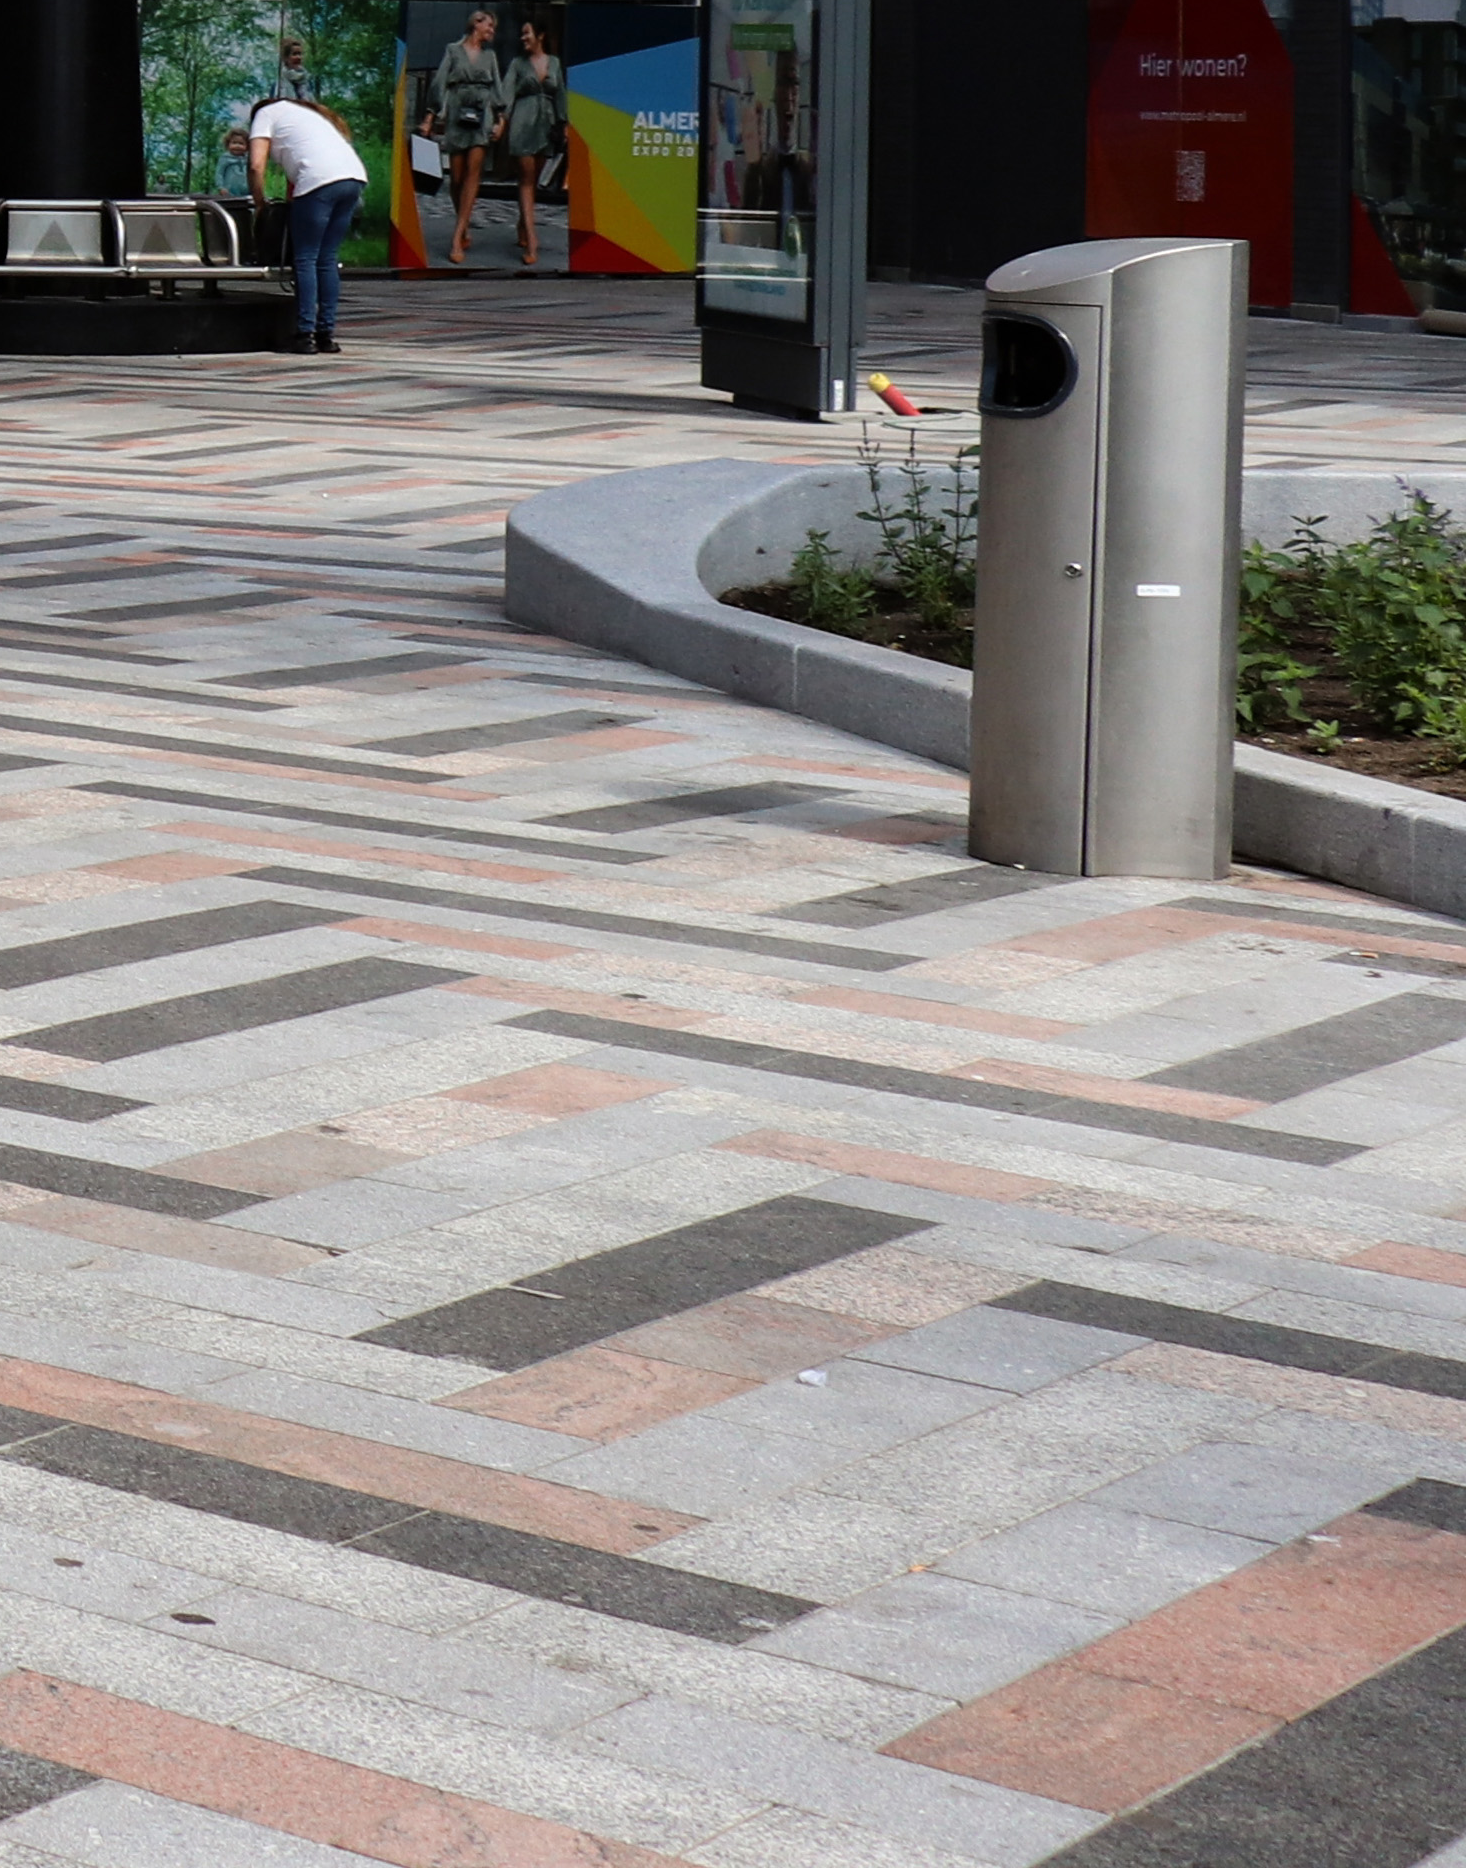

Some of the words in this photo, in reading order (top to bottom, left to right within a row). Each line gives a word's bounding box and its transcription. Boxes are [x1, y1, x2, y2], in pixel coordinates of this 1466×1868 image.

[1139, 53, 1172, 77] Hier
[1176, 54, 1248, 77] wonen?
[632, 145, 670, 157] EXPO
